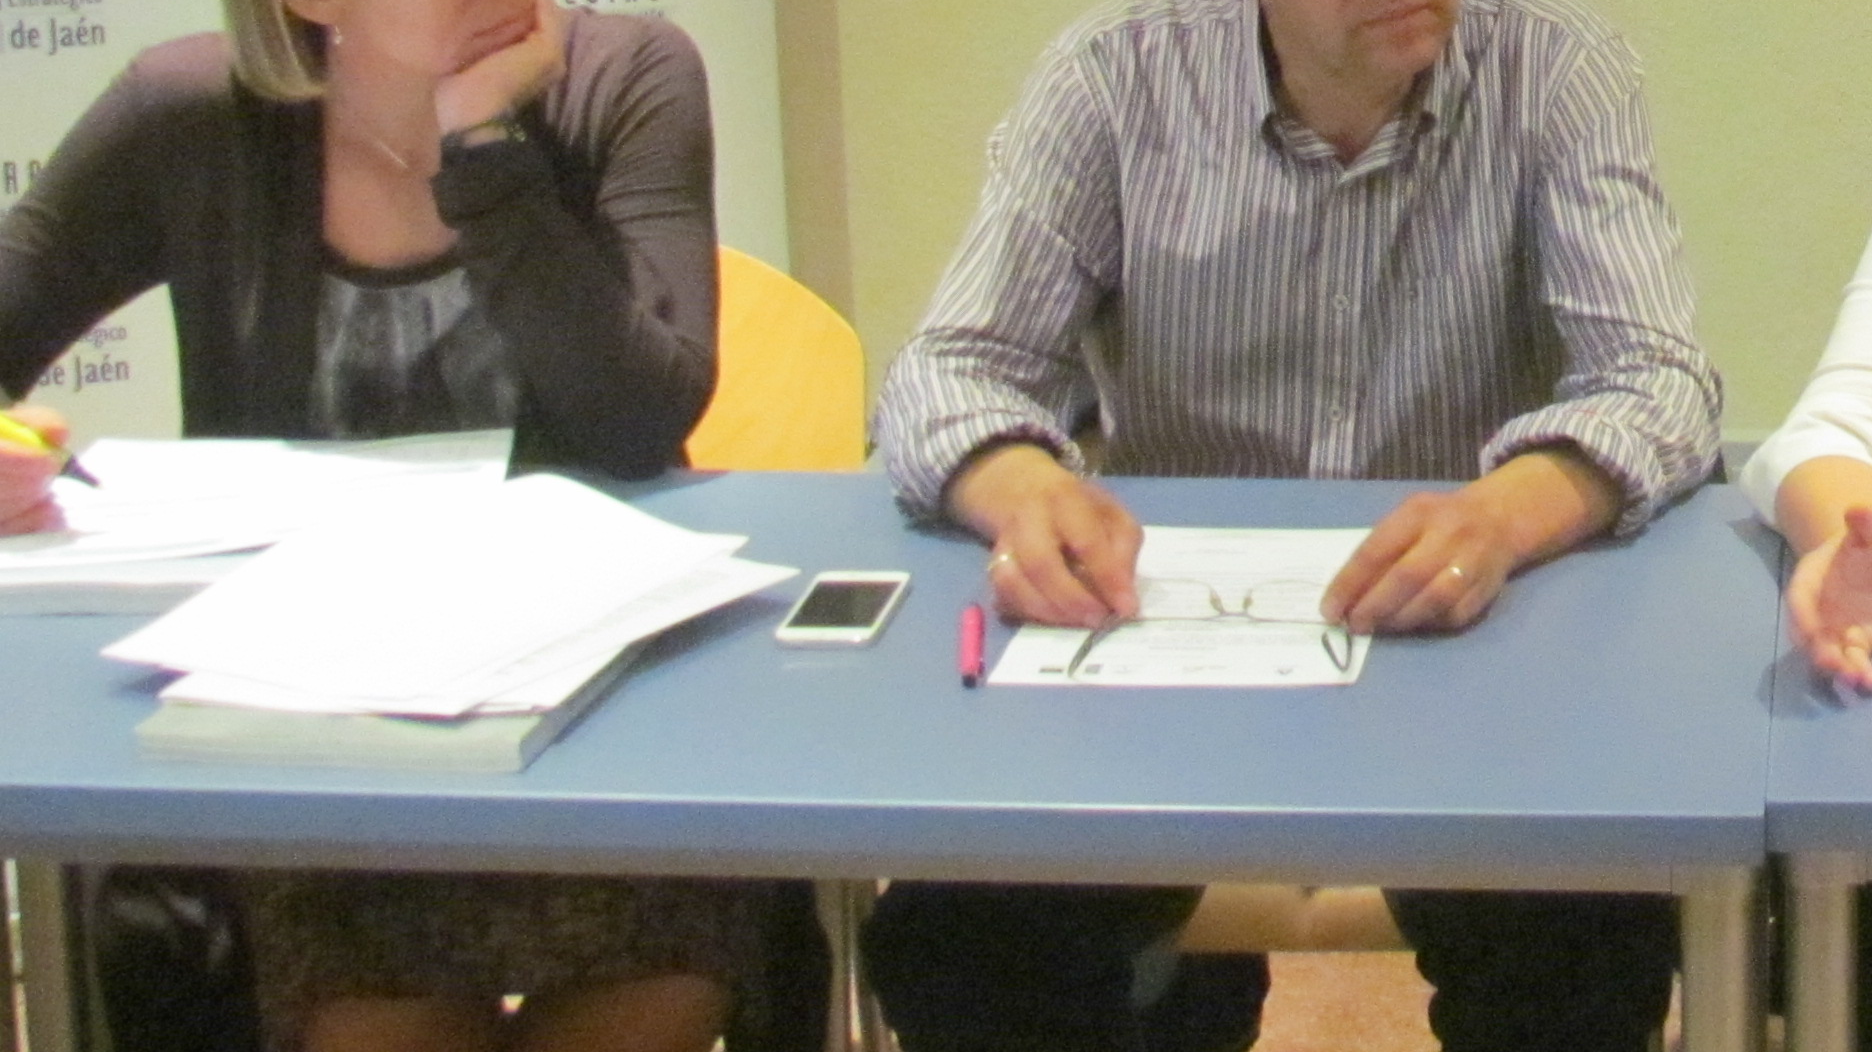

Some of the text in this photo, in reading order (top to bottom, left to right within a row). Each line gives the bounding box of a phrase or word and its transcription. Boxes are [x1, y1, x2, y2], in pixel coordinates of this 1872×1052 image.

[10, 16, 105, 55] de Jaén
[73, 353, 130, 392] Jaén
